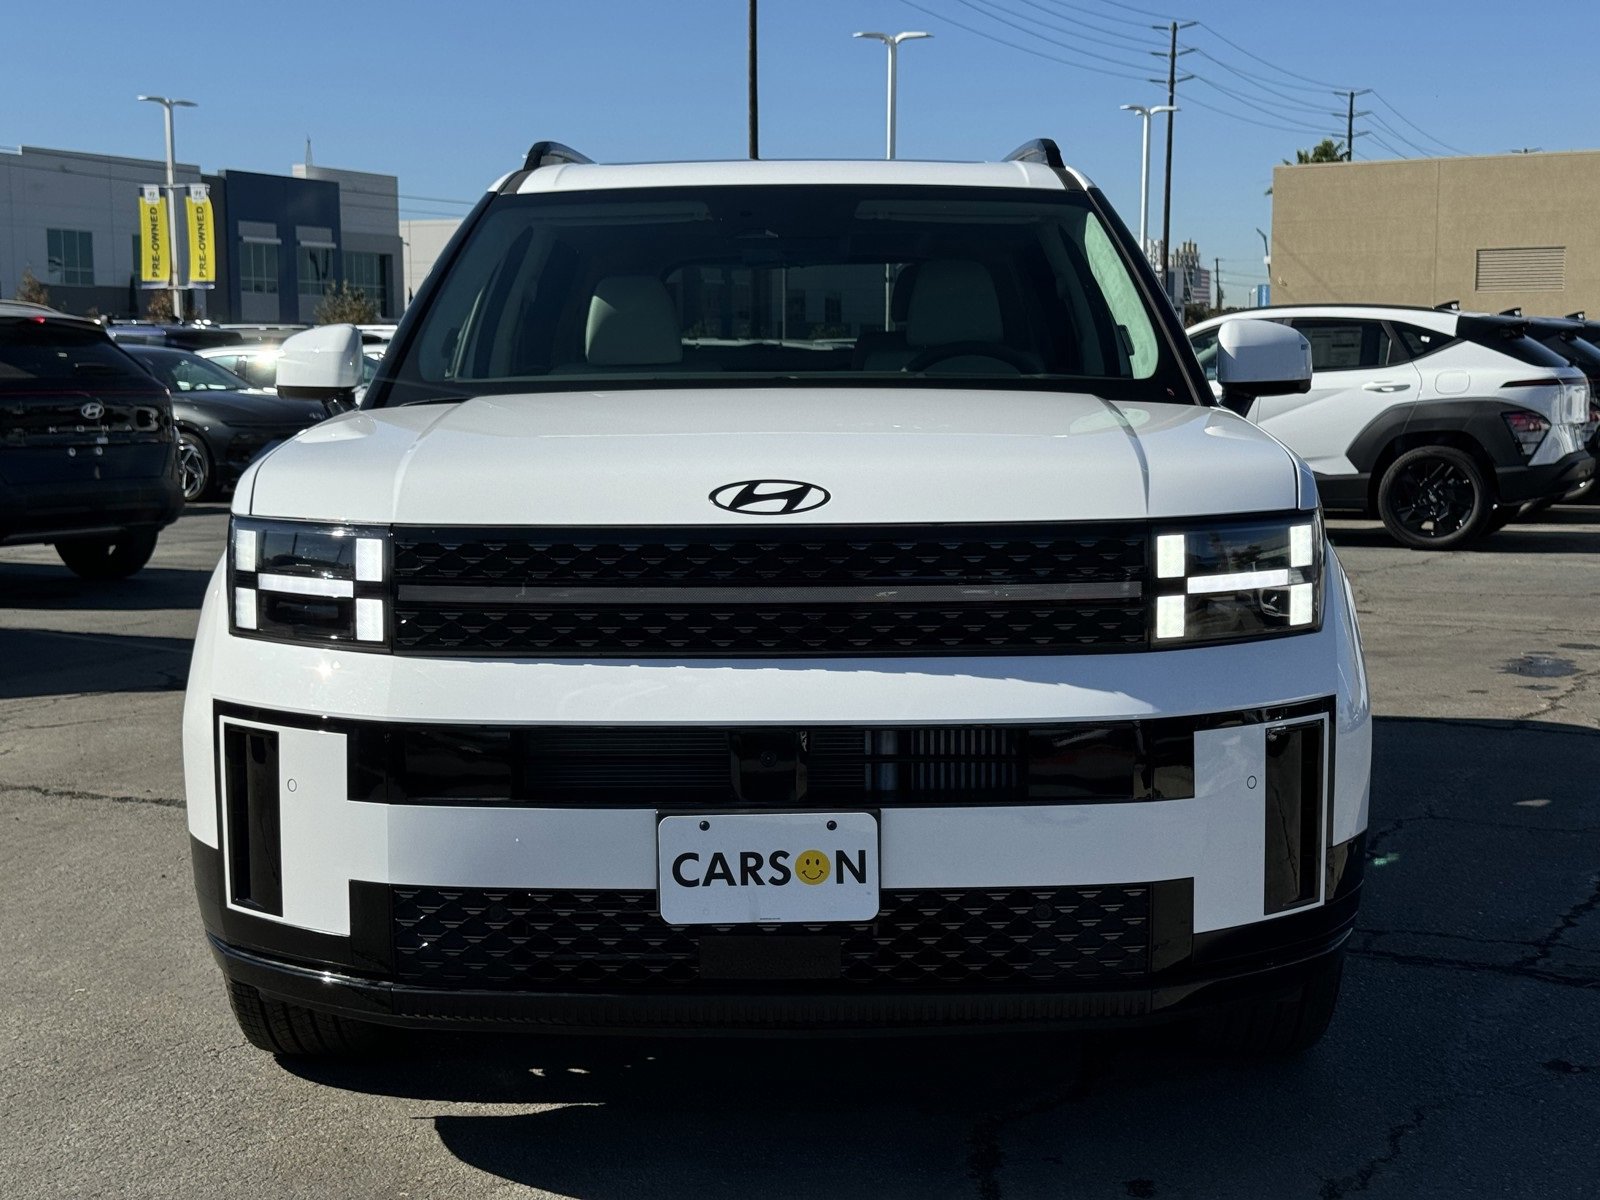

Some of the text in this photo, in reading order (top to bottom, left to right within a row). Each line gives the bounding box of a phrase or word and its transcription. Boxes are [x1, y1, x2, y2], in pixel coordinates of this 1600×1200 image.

[149, 206, 160, 278] PRE-OWNED
[196, 206, 207, 278] PRE-OWNED
[48, 424, 133, 434] KONA
[671, 849, 867, 888] CARSON
